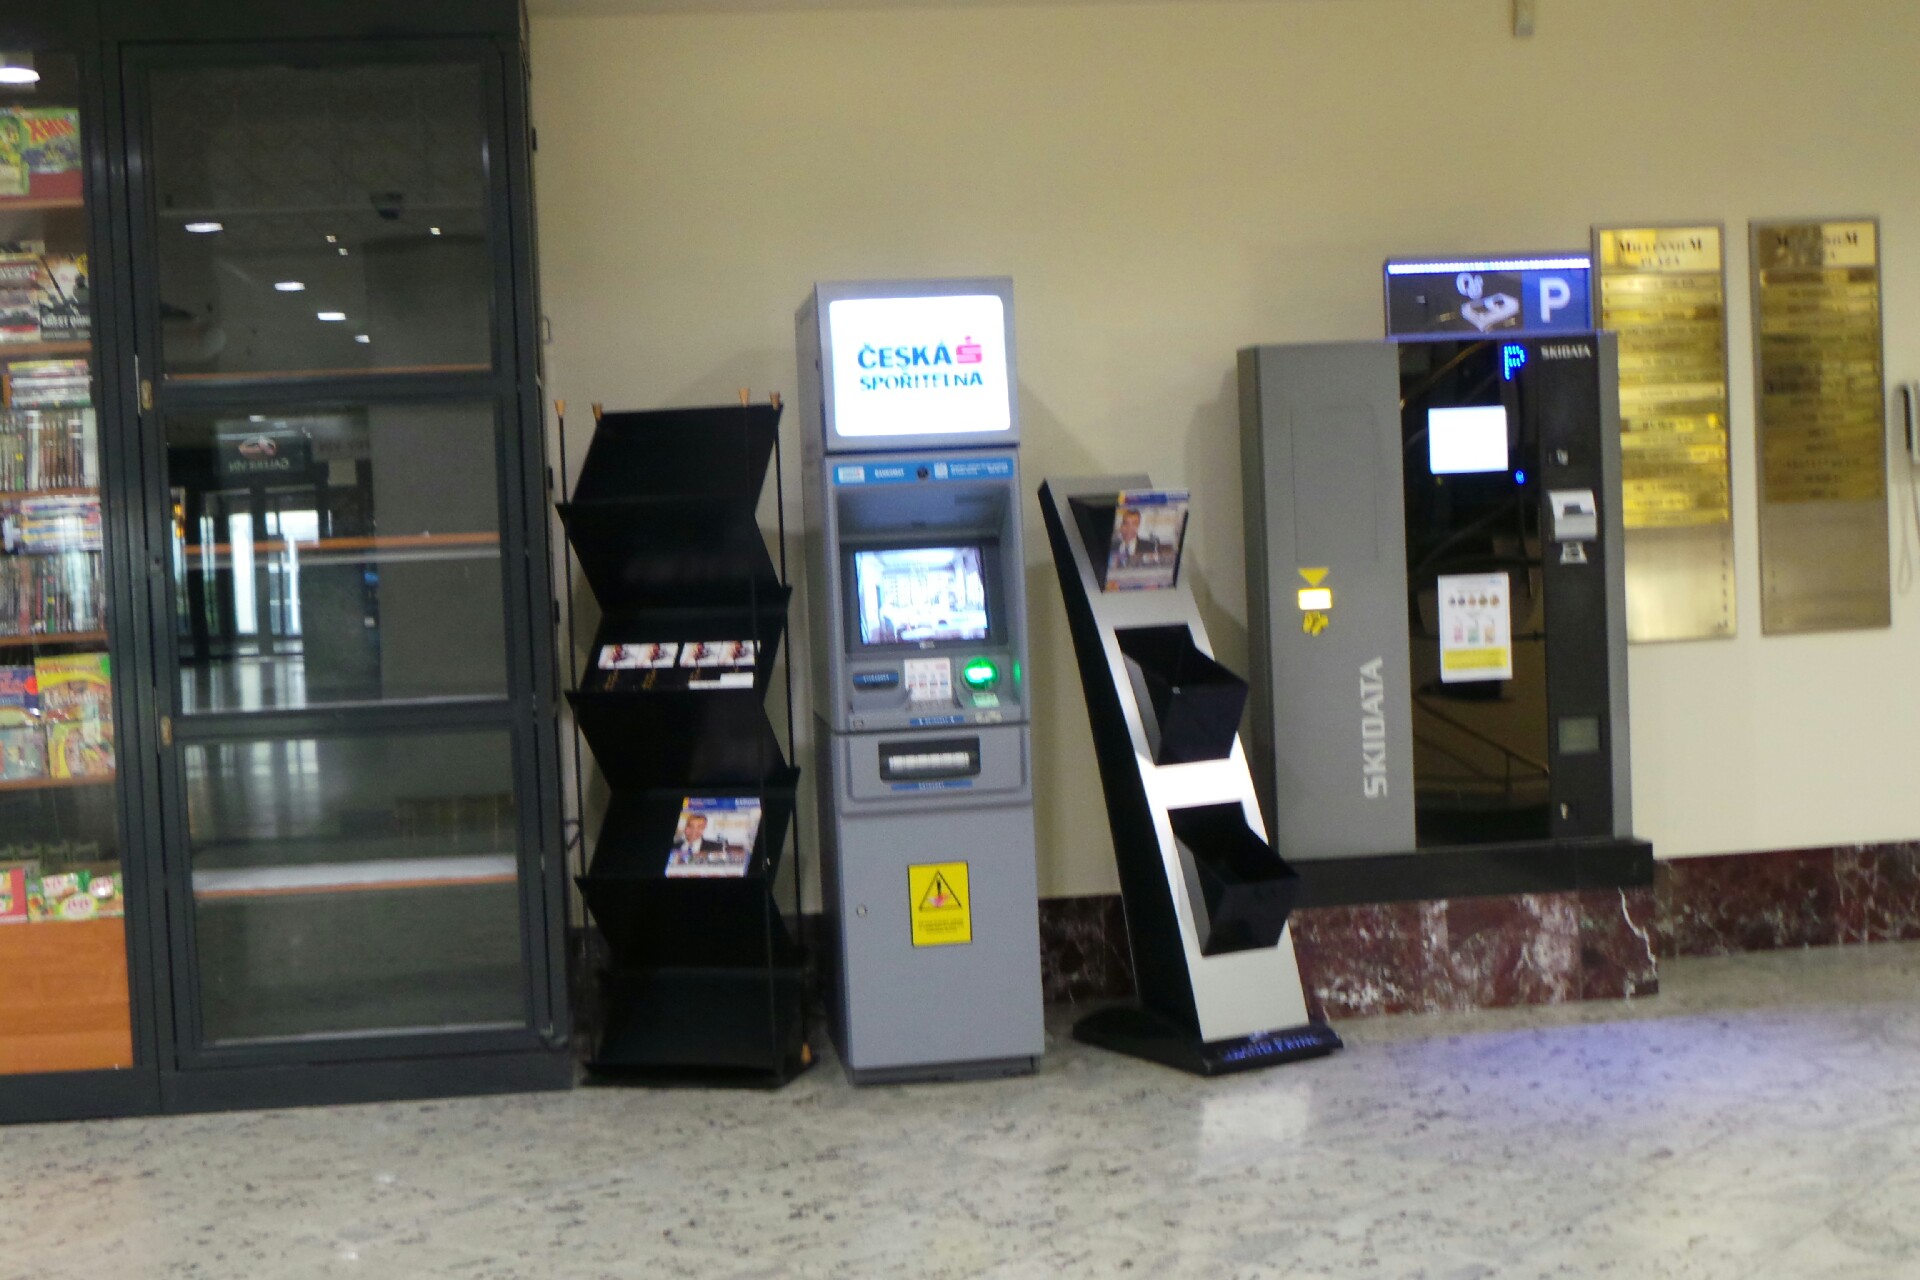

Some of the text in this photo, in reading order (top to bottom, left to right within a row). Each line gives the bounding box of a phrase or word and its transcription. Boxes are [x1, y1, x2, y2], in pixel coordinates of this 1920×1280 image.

[1539, 276, 1571, 324] P
[857, 340, 952, 369] ČESKÁ
[1503, 344, 1526, 381] P
[859, 369, 984, 391] SPOŘITELNA
[1359, 655, 1388, 799] SKIDATA
